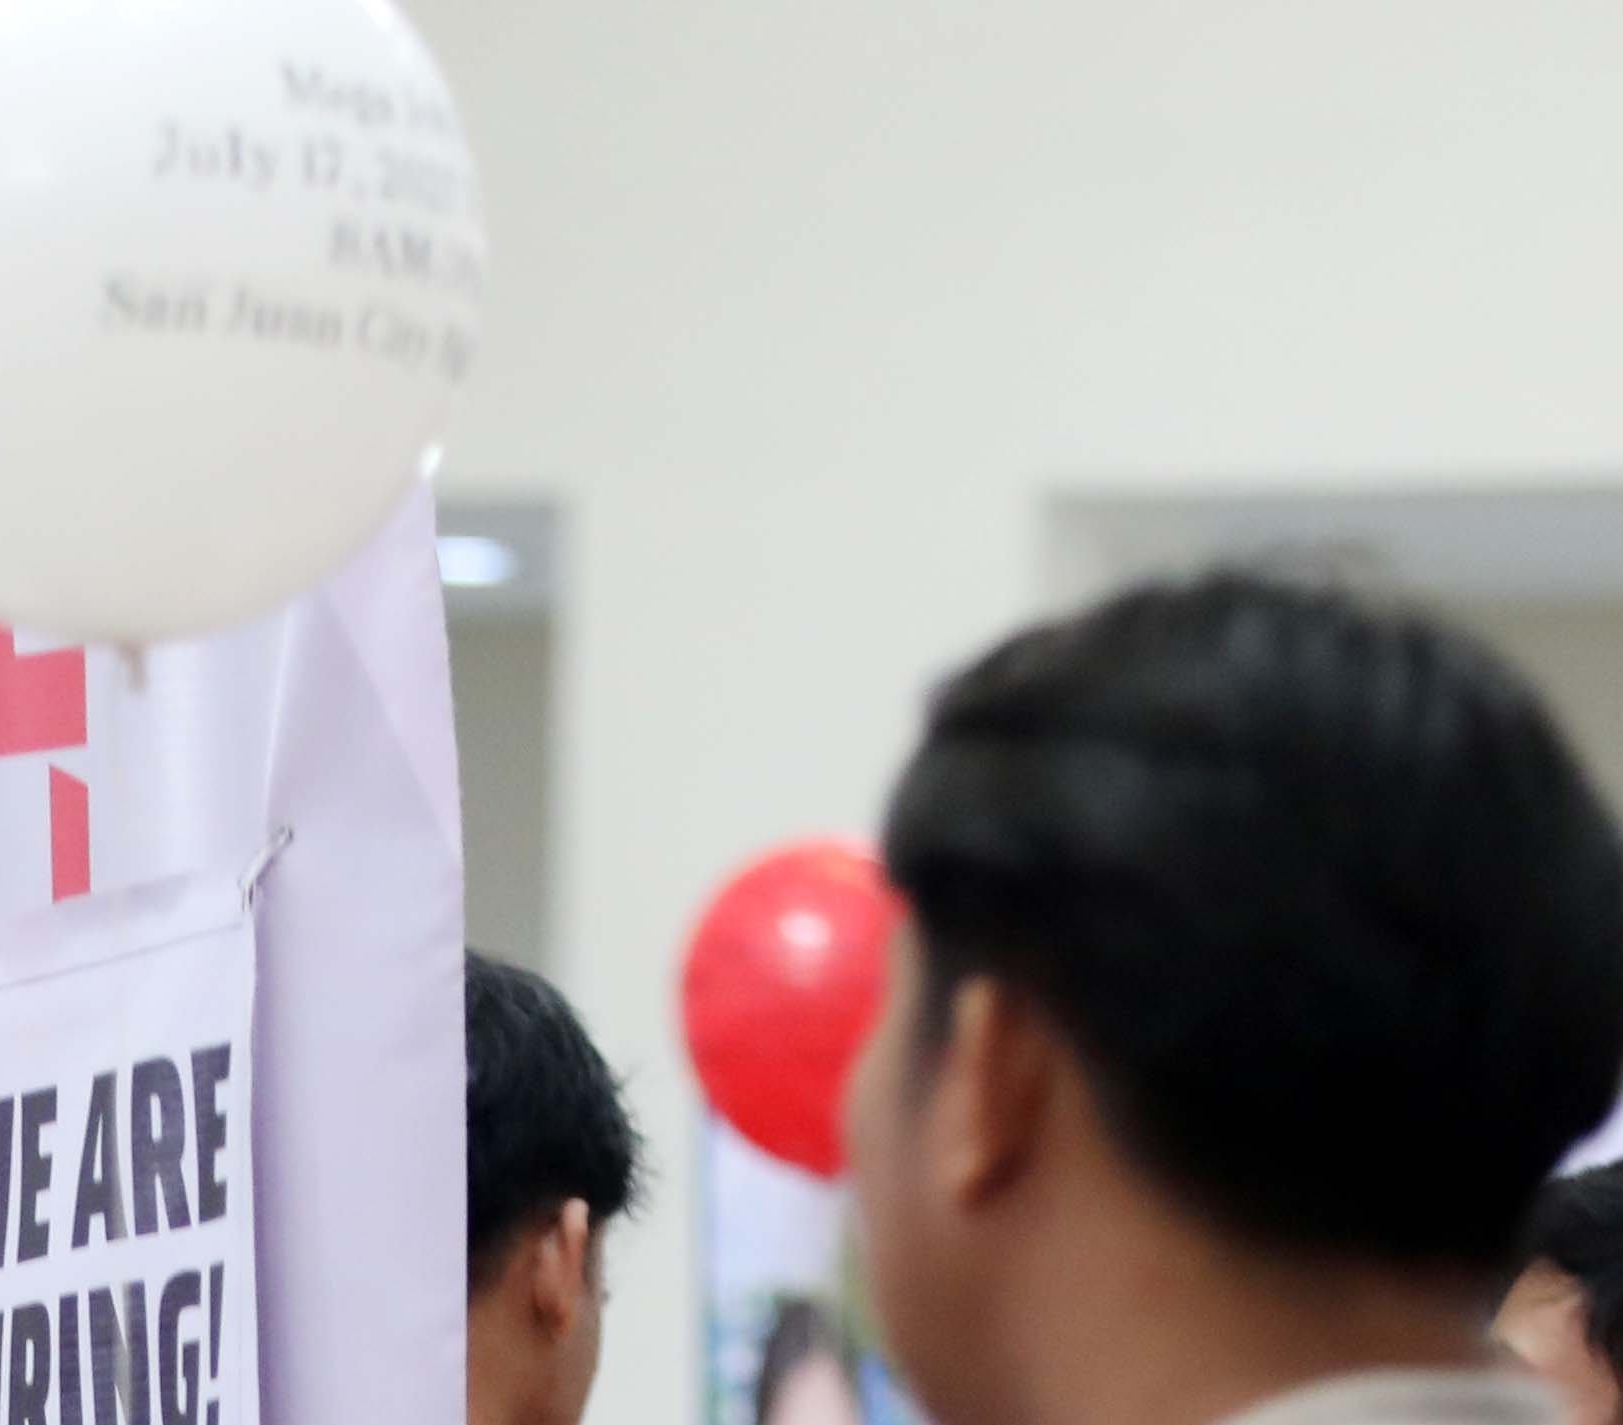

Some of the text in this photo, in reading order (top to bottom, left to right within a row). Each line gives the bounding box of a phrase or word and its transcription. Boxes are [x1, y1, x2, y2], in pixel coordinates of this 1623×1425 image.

[154, 115, 279, 192] July
[99, 270, 210, 332] San
[225, 284, 344, 348] Juan
[71, 1042, 232, 1250] ARE
